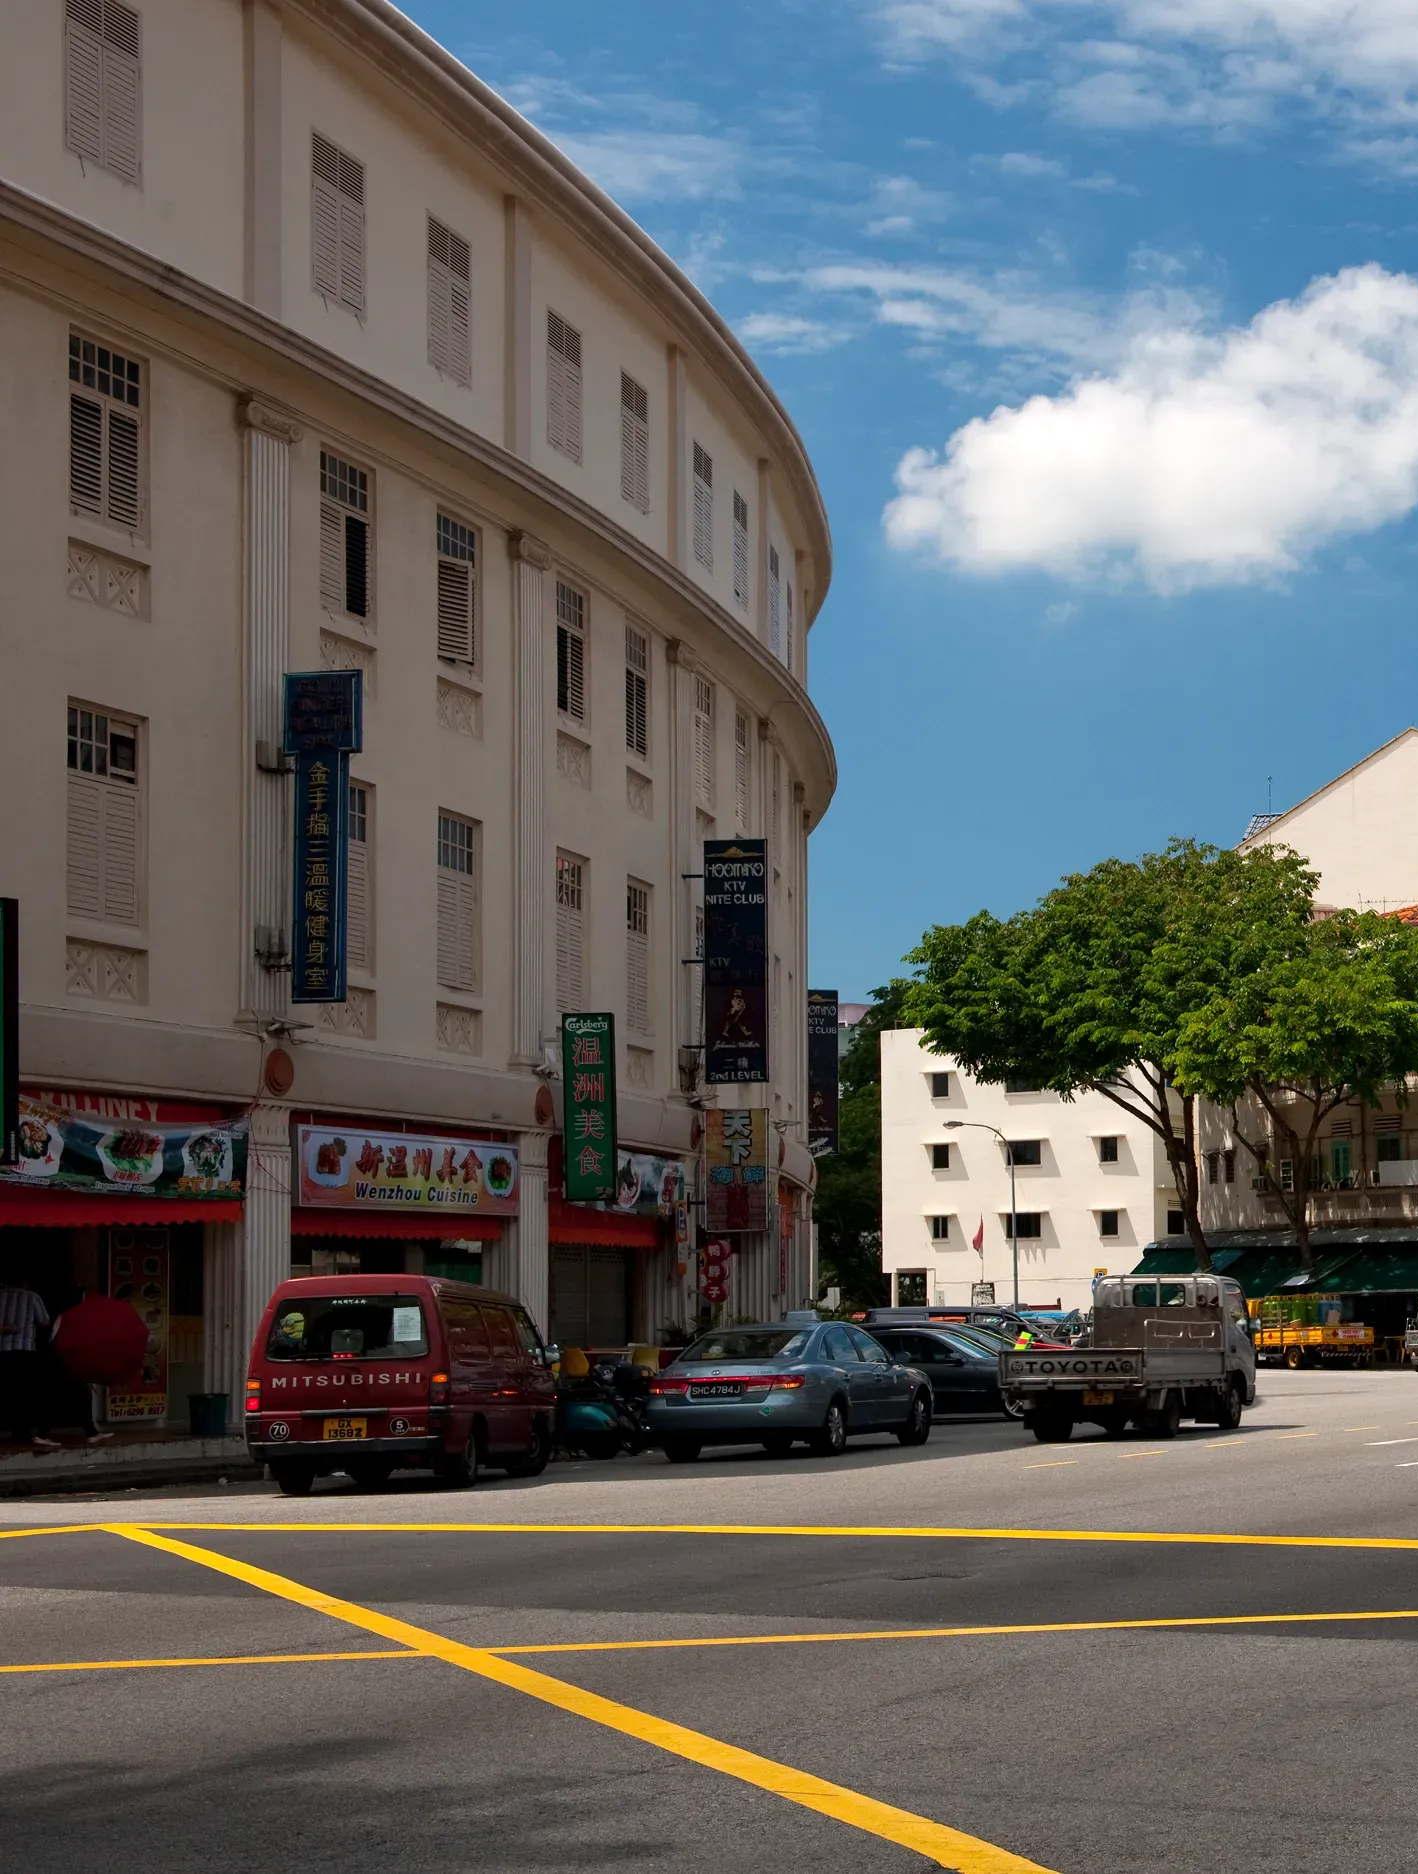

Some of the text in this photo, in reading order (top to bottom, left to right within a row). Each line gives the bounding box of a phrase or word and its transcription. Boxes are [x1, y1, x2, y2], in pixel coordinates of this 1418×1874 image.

[723, 880, 747, 892] KTV
[705, 893, 765, 905] NITE CLUB
[709, 958, 731, 968] KTV
[564, 1017, 609, 1035] Carlsberg
[815, 1026, 837, 1035] CLUB
[710, 1070, 765, 1081] 2nd LEVEL
[572, 1037, 606, 1177] 温洲美食
[354, 1182, 479, 1205] Wenzhou Cuisine
[1025, 1360, 1119, 1374] TOYOTA
[272, 1373, 422, 1388] MITSUBISHI
[691, 1384, 741, 1396] SHC4784J
[338, 1419, 352, 1429] GX
[396, 1420, 404, 1430] 5
[272, 1425, 287, 1436] 70
